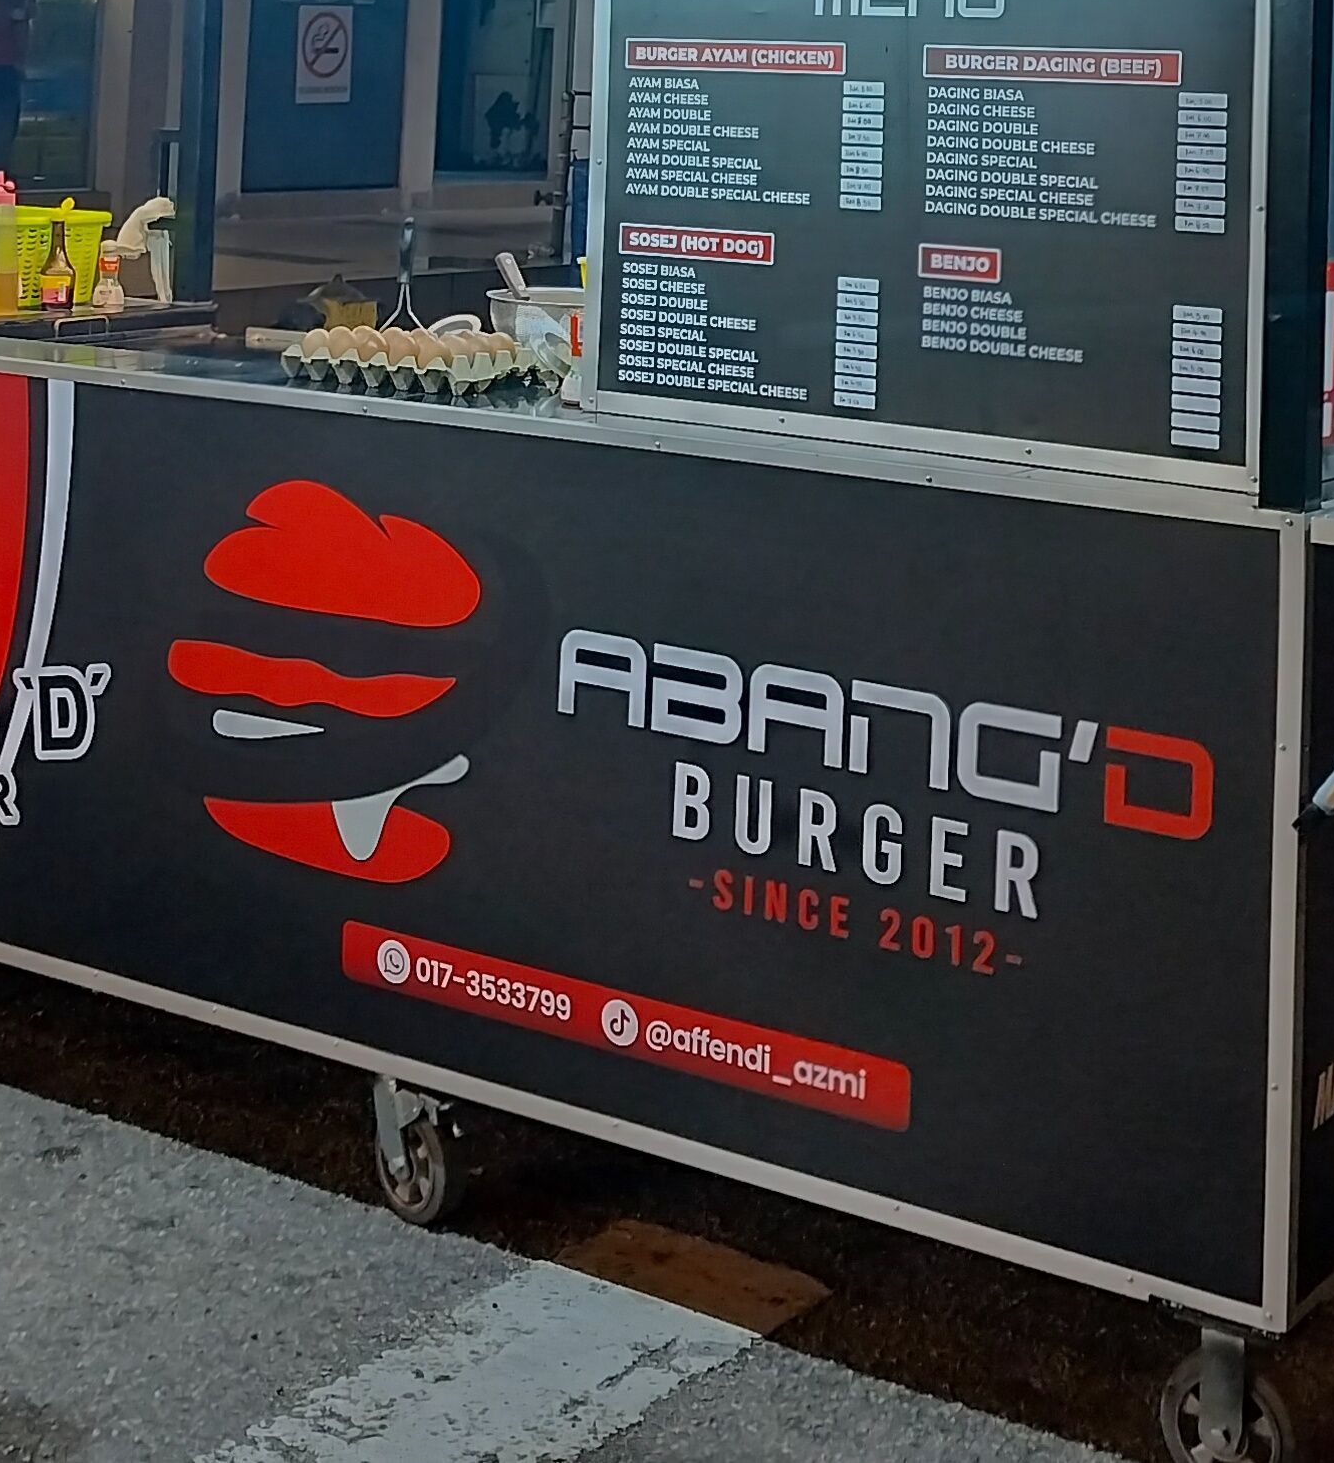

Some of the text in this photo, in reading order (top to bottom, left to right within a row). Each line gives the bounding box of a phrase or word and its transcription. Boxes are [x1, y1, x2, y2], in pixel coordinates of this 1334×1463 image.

[636, 47, 835, 65] BURGER AYAM (CHICKEN)
[945, 54, 1162, 74] BURGER DAGING (BEEF)
[629, 77, 698, 89] AYAM BIASA
[629, 93, 708, 104] AYAM CHEESE
[929, 87, 1024, 100] DAGING BIASA
[629, 108, 711, 120] AYAM DOUBLE
[928, 103, 1035, 117] DAGING CHEESE
[628, 123, 758, 138] AYAM DOUBLE CHEESE
[928, 120, 1038, 134] DAGING DOUBLE
[627, 138, 710, 151] AYAM SPECIAL
[928, 136, 1094, 154] DAGING DOUBLE CHEESE
[627, 153, 761, 169] AYAM DOUBLE SPECIAL
[927, 152, 1036, 168] DAGING SPECIAL
[626, 168, 756, 184] AYAM SPECIAL CHEESE
[927, 169, 1098, 188] DAGING DOUBLE SPECIAL
[626, 183, 810, 204] AYAM DOUBLE SPECIAL CHEESE
[926, 185, 1093, 205] DAGING SPECIAL CHEESE
[926, 201, 1156, 226] DAGING DOUBLE SPECIAL CHEESE
[630, 232, 764, 254] SOSEJ (HOT DOG)
[623, 262, 695, 277] SOSEJ BIASA
[931, 254, 989, 272] BENJO
[623, 278, 705, 294] SOSEJ CHEESE
[622, 293, 707, 310] SOSEJ DOUBLE
[924, 287, 1011, 304] BENJO BIASA
[621, 309, 755, 330] SOSEJ DOUBLE CHEESE
[923, 303, 1023, 322] BENJO CHEESE
[620, 324, 706, 341] SOSEJ SPECIAL
[923, 319, 1026, 339] BENJO DOUBLE
[620, 339, 758, 362] SOSEJ DOUBLE SPECIAL
[922, 336, 1082, 362] BENJO DOUBLE CHEESE
[619, 354, 754, 378] SOSEJ SPECIAL CHEESE
[619, 370, 807, 399] SOSEJ DOUBLE SPECIAL CHEESE
[558, 629, 1214, 840] ABANG'D
[672, 761, 1040, 919] BURGER
[415, 957, 867, 1100] 017-3533799 @affendi_azmi
